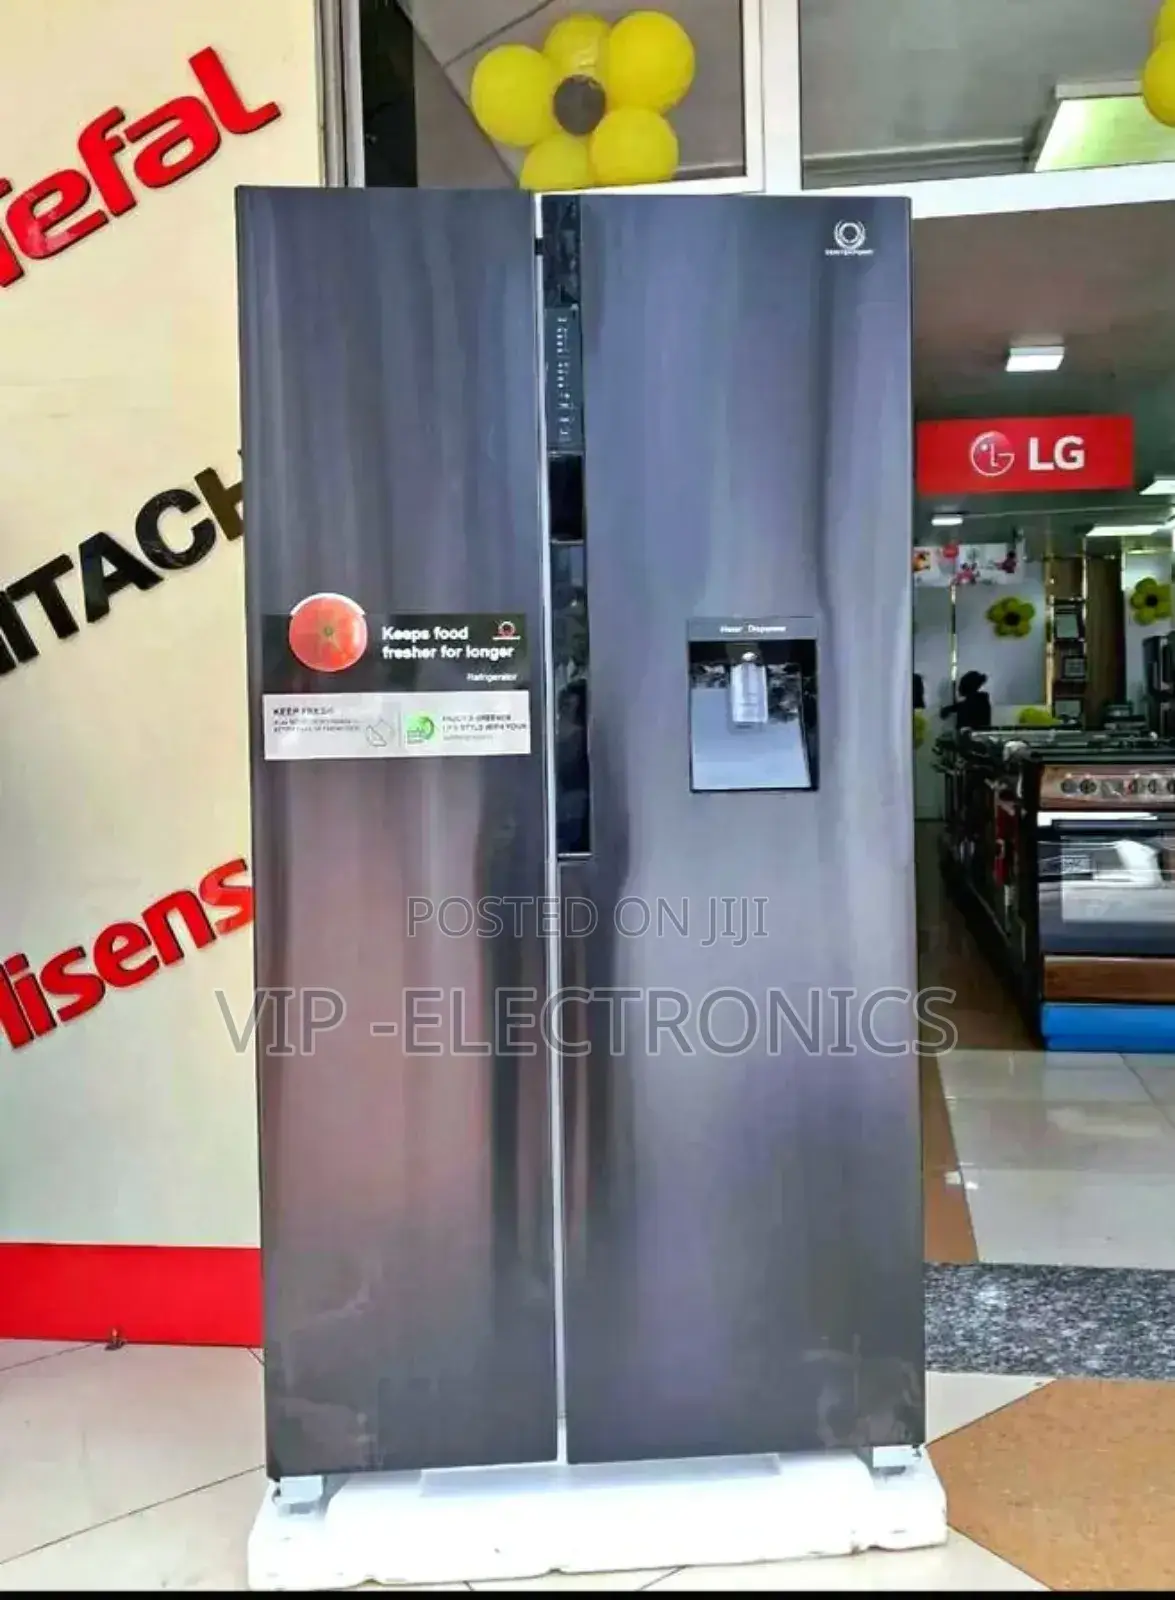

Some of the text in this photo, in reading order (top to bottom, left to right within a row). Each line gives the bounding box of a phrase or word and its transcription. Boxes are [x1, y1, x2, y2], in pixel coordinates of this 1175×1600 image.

[1028, 435, 1085, 471] LG
[381, 626, 469, 643] Keeps food
[382, 645, 515, 661] fresher for longer
